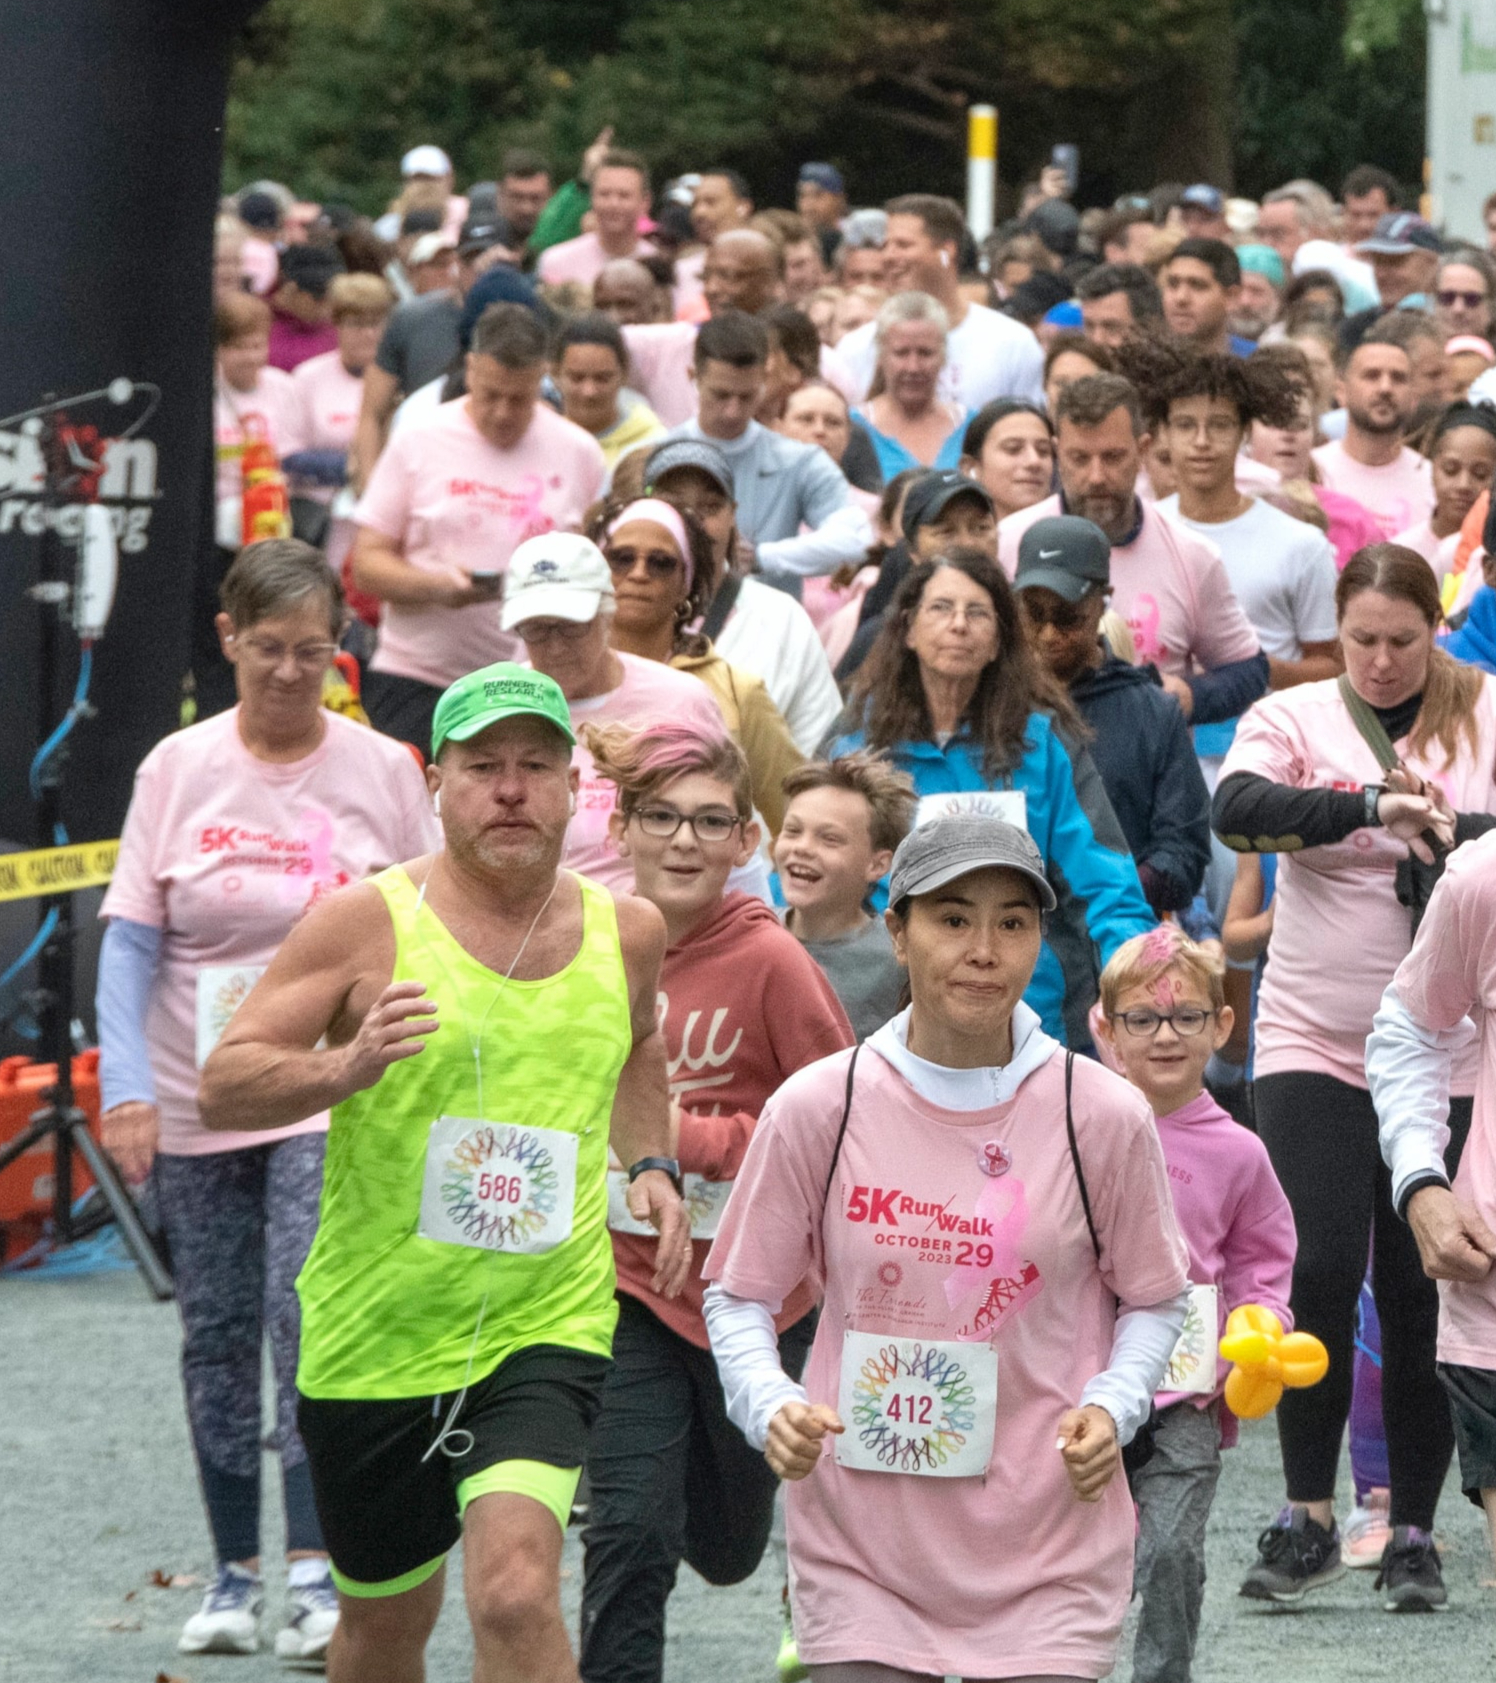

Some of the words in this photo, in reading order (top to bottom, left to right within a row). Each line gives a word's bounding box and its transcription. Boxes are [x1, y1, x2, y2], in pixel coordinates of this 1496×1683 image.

[200, 826, 238, 853] 5K
[284, 856, 313, 875] 29
[478, 1173, 522, 1204] 586
[846, 1185, 902, 1227] 5K
[874, 1233, 952, 1251] OCTOBER
[954, 1241, 994, 1268] 29
[918, 1251, 952, 1264] 2023
[886, 1393, 932, 1424] 412
